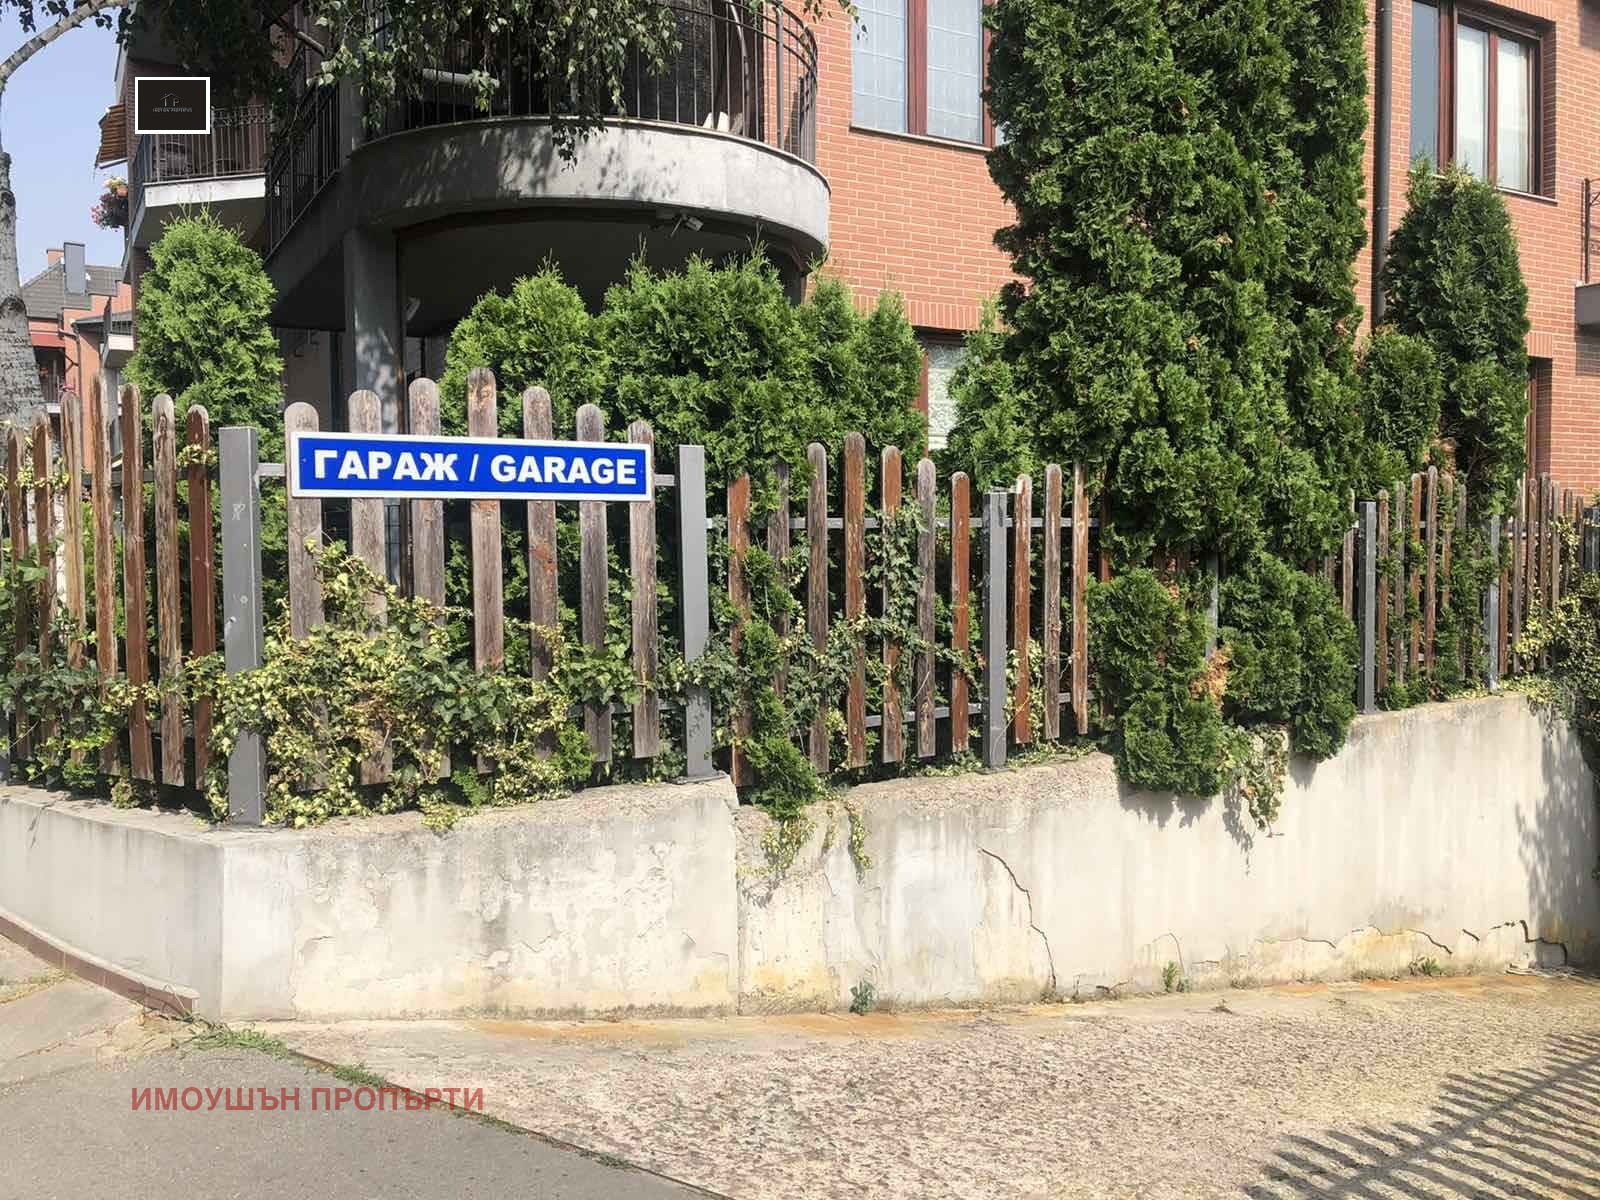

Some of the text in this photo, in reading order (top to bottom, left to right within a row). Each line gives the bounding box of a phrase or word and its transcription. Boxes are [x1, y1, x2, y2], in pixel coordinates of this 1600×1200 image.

[314, 449, 637, 485] ГАРАЖ / GARAGE
